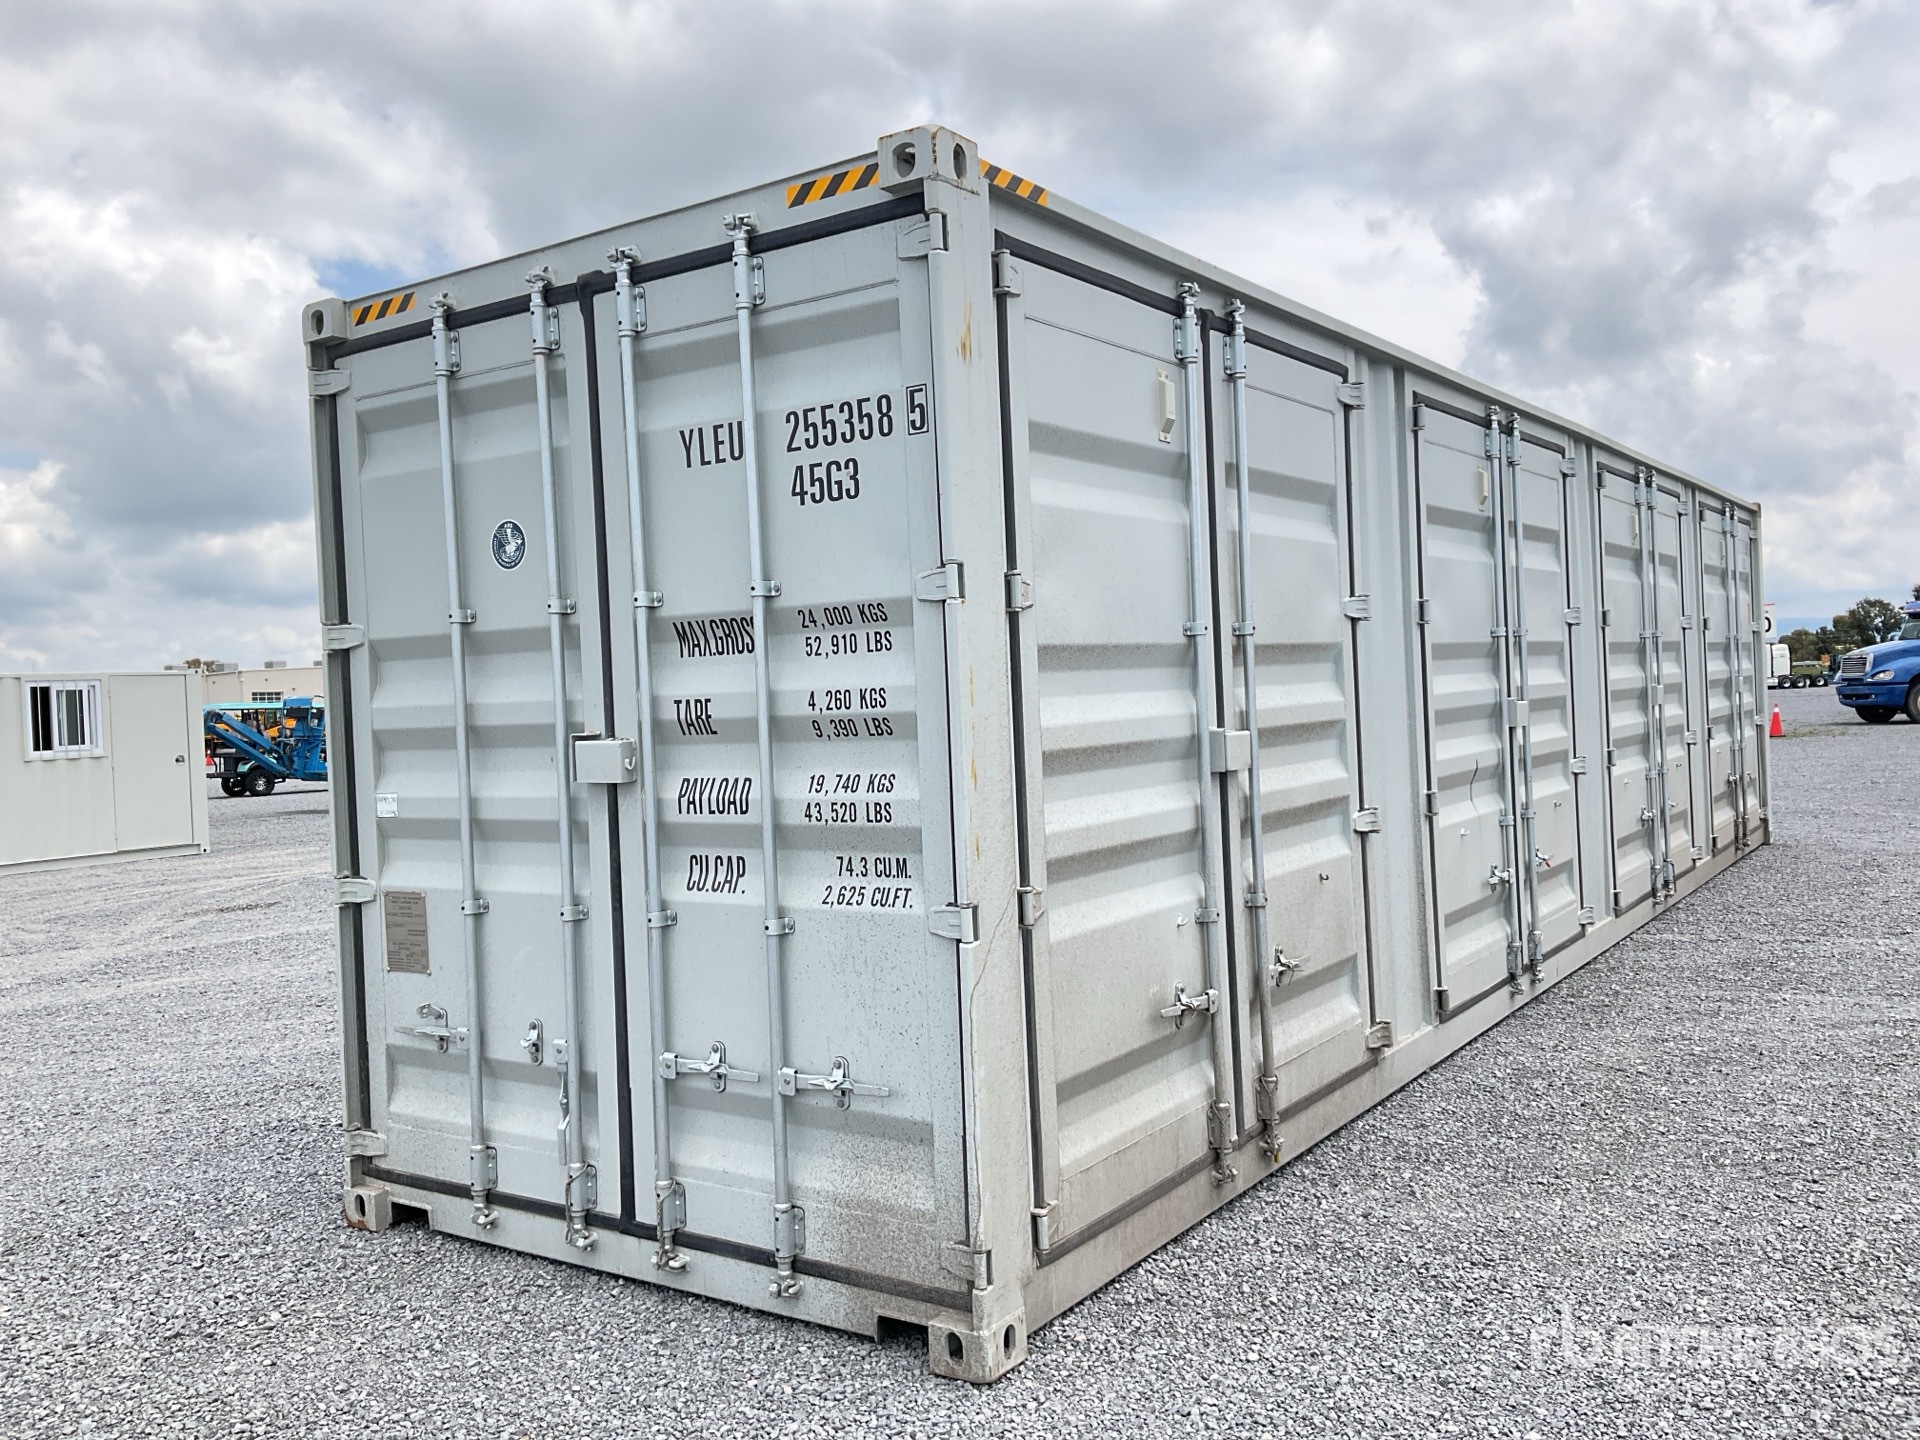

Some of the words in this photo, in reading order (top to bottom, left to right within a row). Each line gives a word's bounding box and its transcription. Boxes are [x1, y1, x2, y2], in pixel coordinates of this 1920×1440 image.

[679, 420, 744, 468] YLEU
[785, 393, 893, 453] 255358
[908, 387, 927, 431] 5
[791, 457, 860, 506] 45G3
[797, 605, 853, 630] 24,000
[857, 602, 888, 624] KGS
[673, 616, 755, 658] MAX.GROS
[805, 632, 858, 659] 52,910
[866, 630, 893, 653] LBS
[808, 689, 851, 714] 4,260
[859, 687, 887, 710] KGS
[674, 698, 718, 736] TARE
[812, 718, 859, 741] 9,390
[863, 717, 893, 737] LBS
[677, 777, 752, 815] PAYLOAD
[808, 774, 861, 796] 19,740
[866, 773, 896, 794] KGS
[804, 802, 857, 826] 43,520
[866, 802, 892, 824] LBS
[686, 854, 746, 894] CU.CAP.
[836, 856, 868, 877] 74.3
[874, 856, 912, 879] CU.M.
[821, 885, 866, 908] 2,625
[870, 886, 913, 909] CU.FT.
